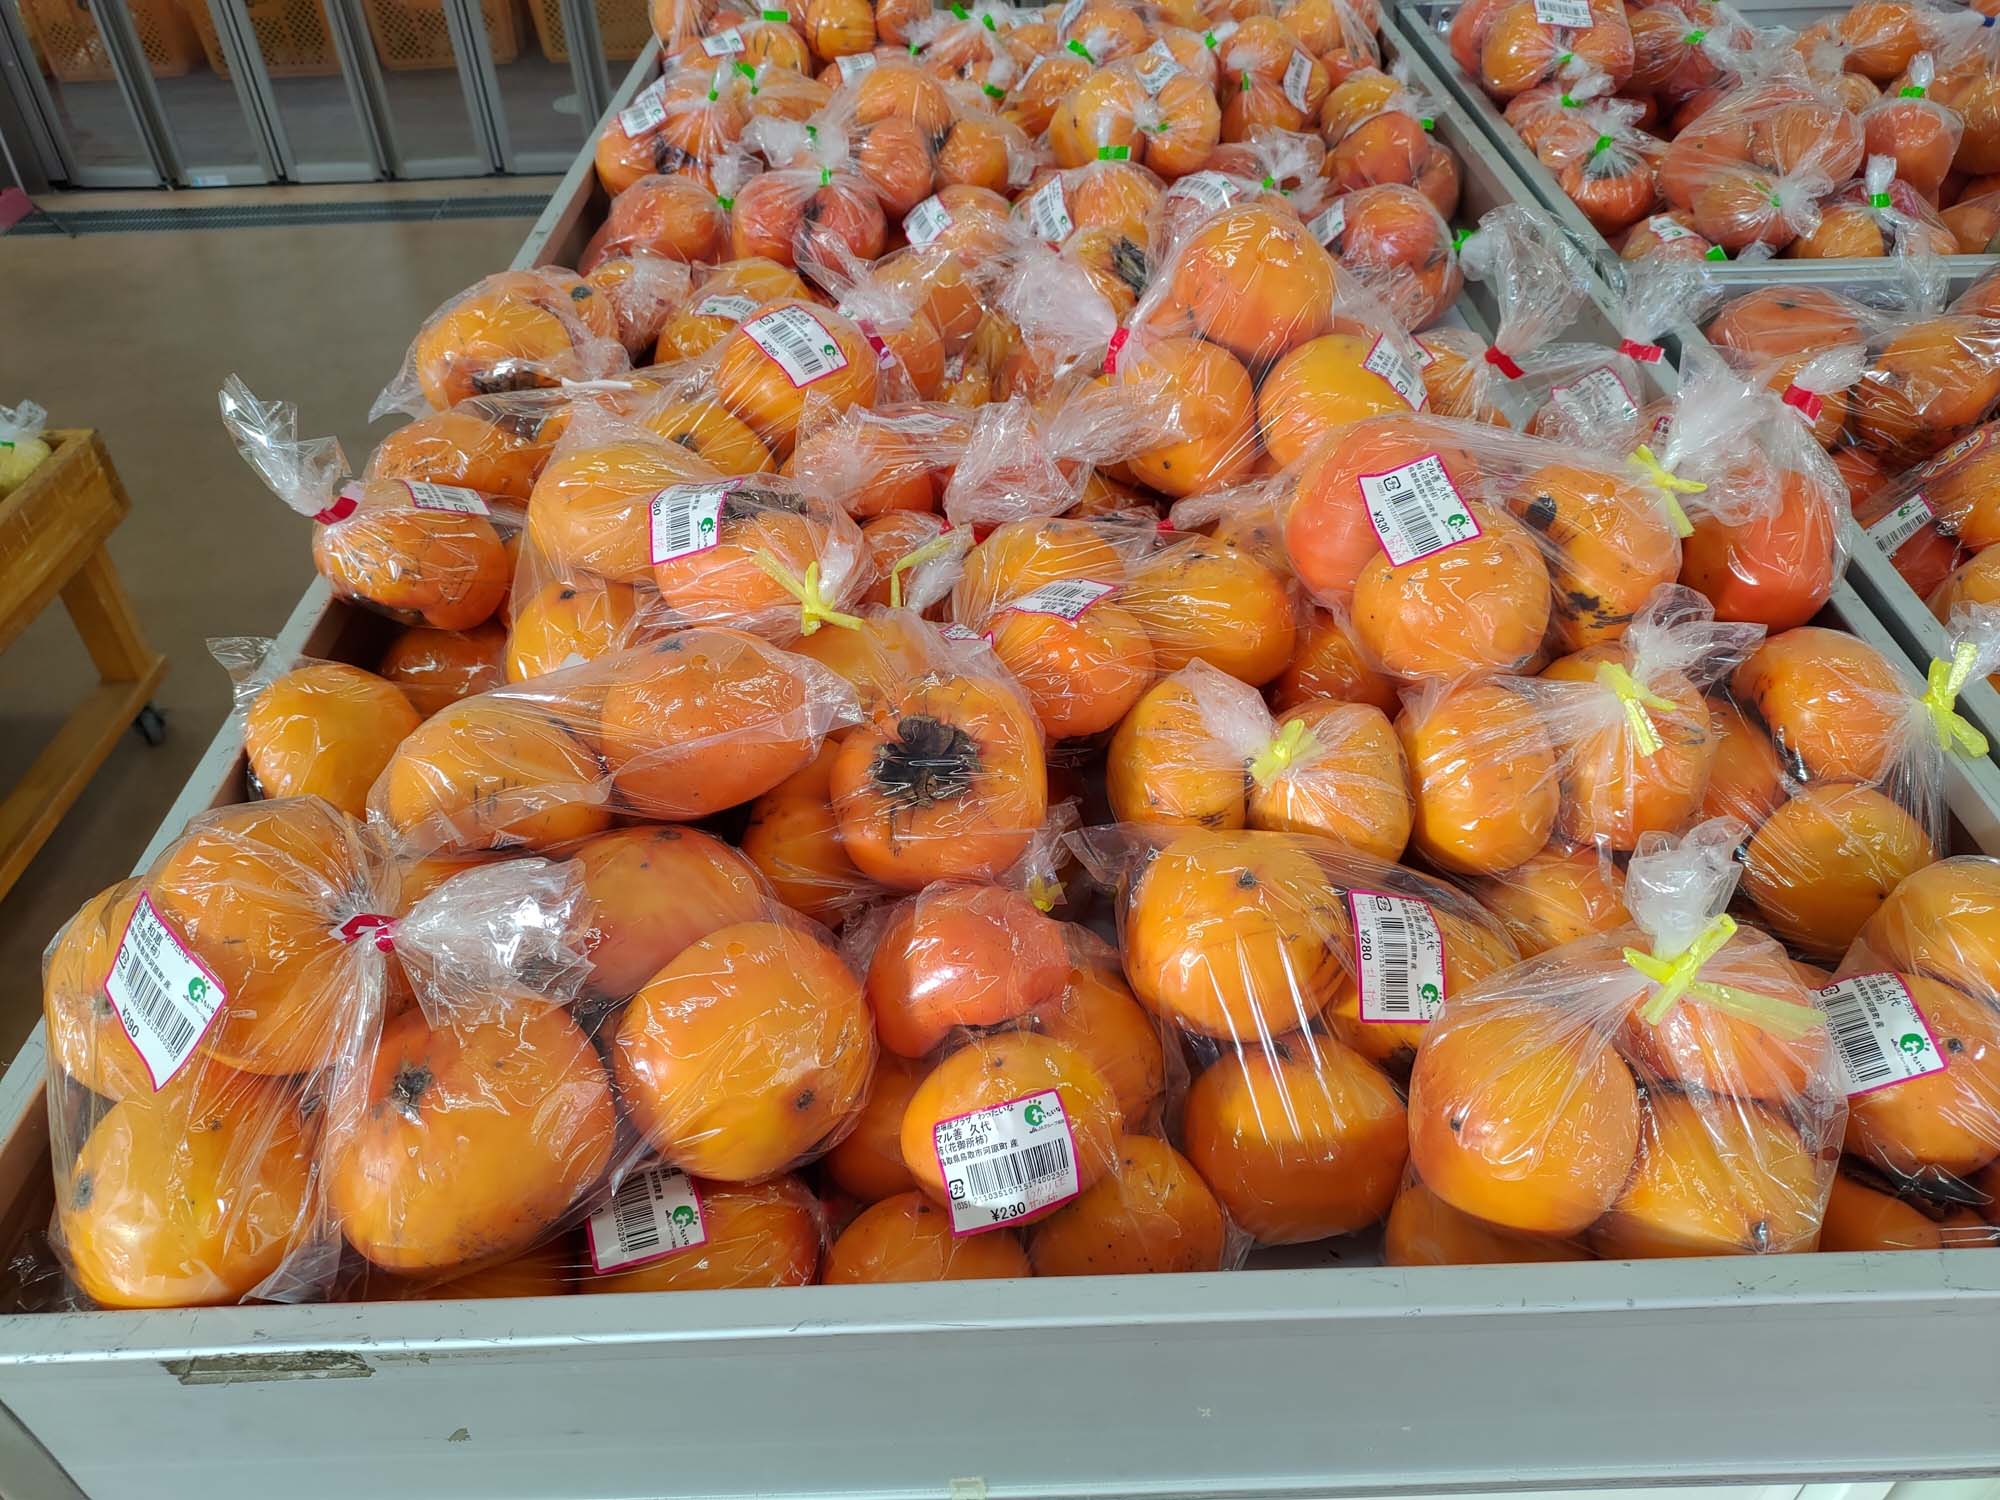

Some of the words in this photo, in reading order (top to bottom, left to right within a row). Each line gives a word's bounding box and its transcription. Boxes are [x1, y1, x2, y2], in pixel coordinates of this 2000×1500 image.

[1373, 510, 1390, 534] ¥330
[1359, 929, 1372, 960] ¥280
[120, 1003, 140, 1040] ¥390
[968, 1119, 992, 1136] 久代
[990, 1200, 1026, 1223] ¥230
